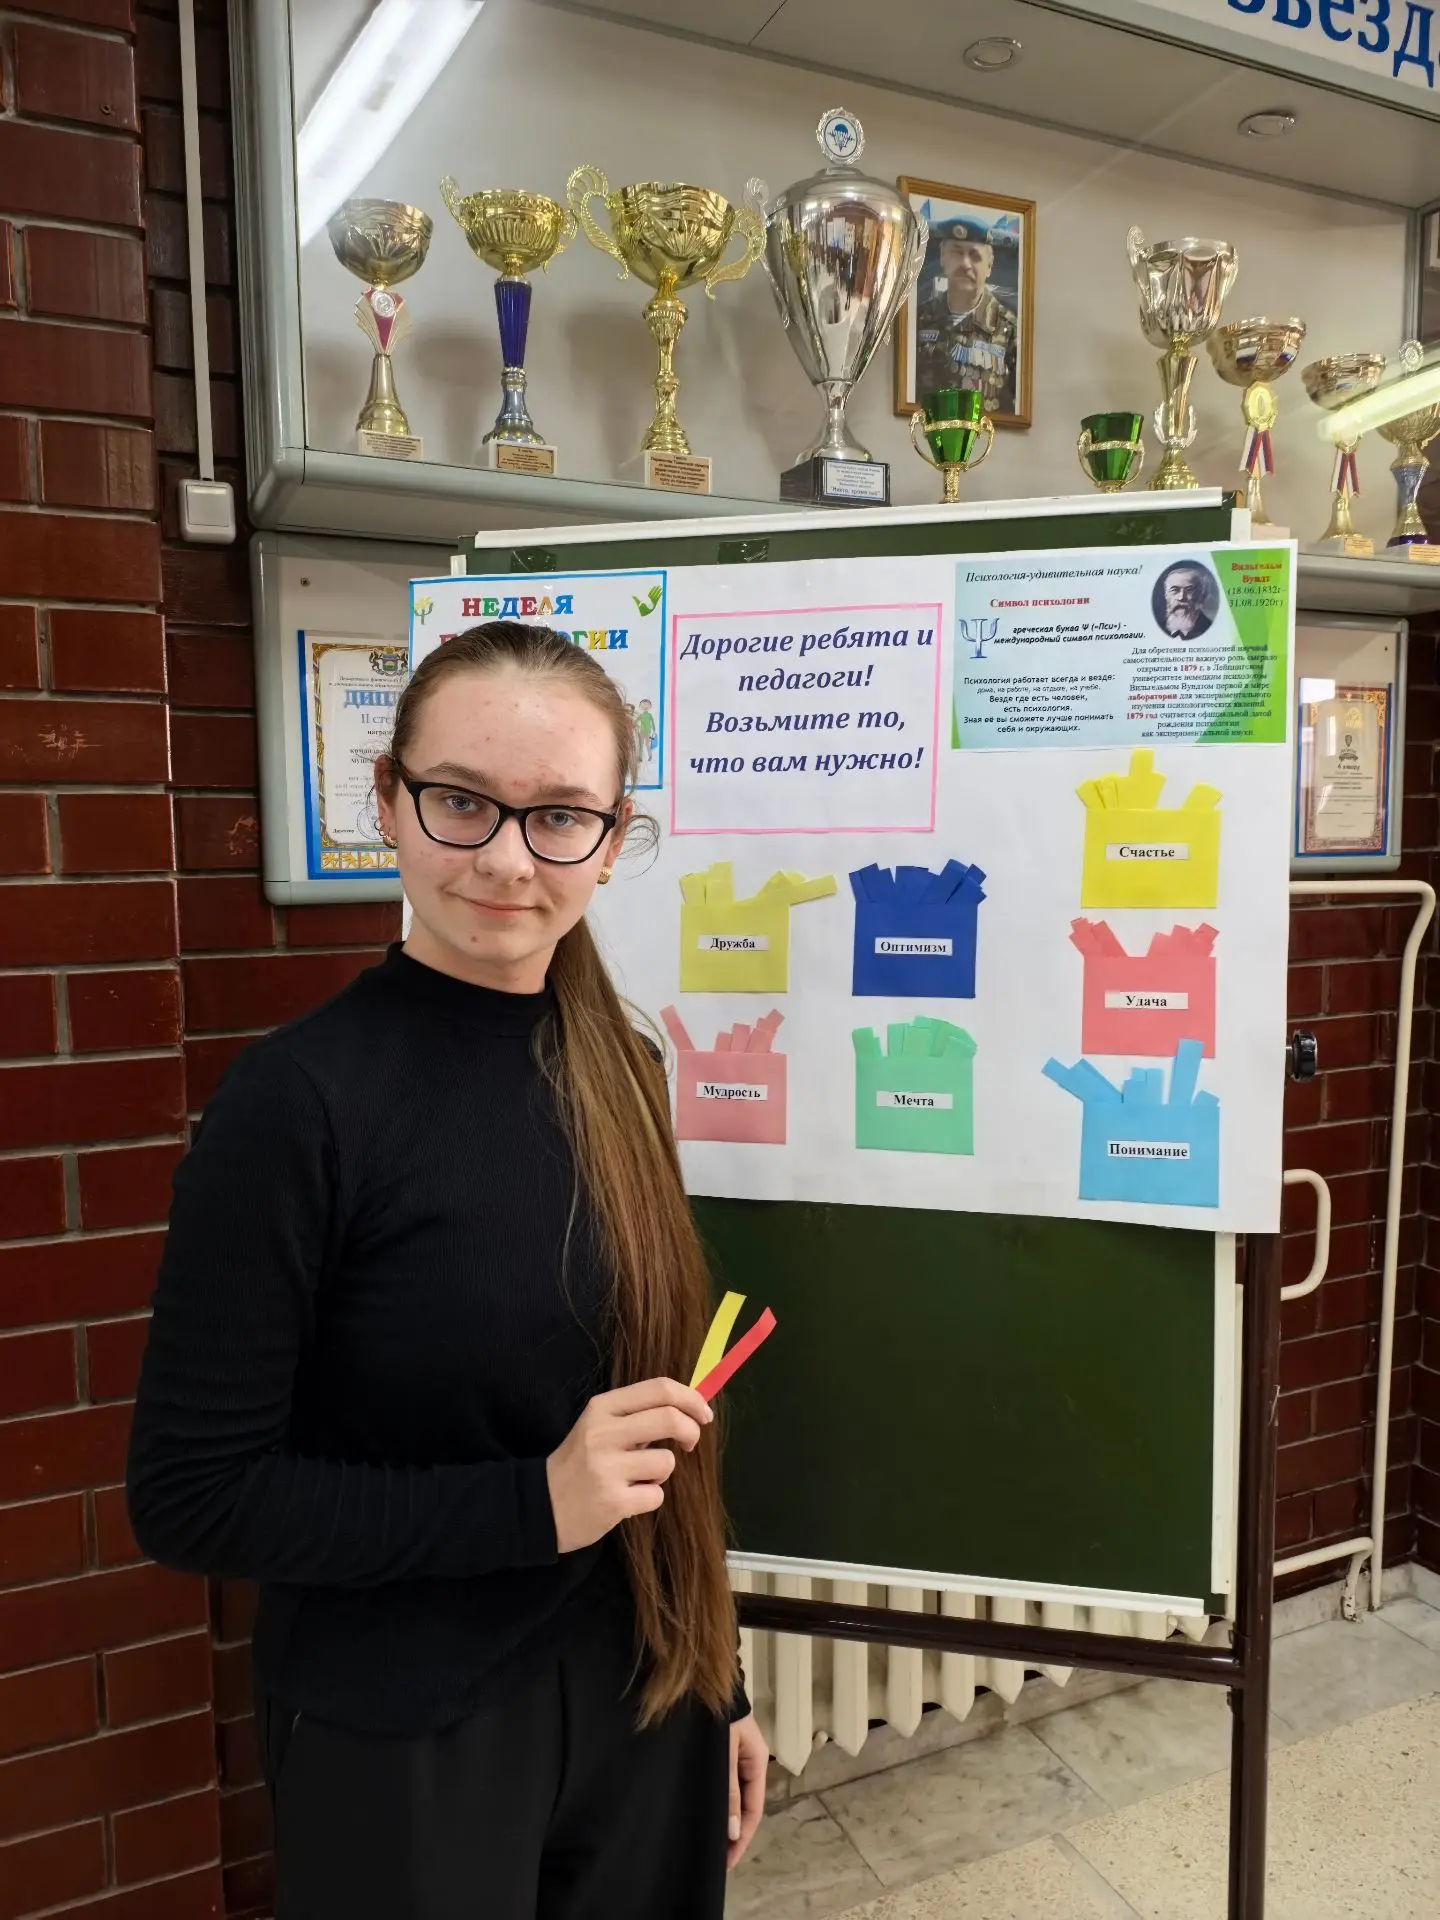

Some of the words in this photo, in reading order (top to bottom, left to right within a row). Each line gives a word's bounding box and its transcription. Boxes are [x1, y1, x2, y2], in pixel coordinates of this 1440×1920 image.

[966, 568, 1104, 583] Психология-удивительная
[1107, 565, 1143, 577] наука!
[462, 595, 574, 620] НЕДЕЛЯ
[990, 599, 1029, 608] Символ
[1032, 597, 1090, 607] психологии
[1013, 625, 1054, 634] греческая
[1056, 624, 1079, 633] буква
[680, 631, 794, 661] Дорогие
[799, 629, 908, 658] ребята
[917, 629, 934, 647] и
[994, 635, 1060, 645] международный
[1063, 634, 1092, 642] символ
[1095, 632, 1146, 641] психологии.
[1180, 664, 1197, 672] 1879
[738, 665, 874, 694] педагоги!
[964, 677, 1010, 685] Психология
[1013, 676, 1048, 685] работает
[1051, 675, 1078, 683] всегда
[1089, 674, 1116, 682] везде:
[990, 695, 1013, 703] Везде
[1024, 705, 1072, 713] психология.
[705, 711, 851, 734] Возьмите
[857, 711, 906, 733] то,
[1046, 715, 1072, 723] лучше
[1075, 714, 1114, 722] понимать
[998, 725, 1015, 733] себя
[1026, 725, 1080, 734] окружающих.
[690, 753, 746, 775] что
[752, 753, 807, 773] вам
[814, 746, 924, 778] нужно!
[1119, 845, 1175, 859] Счастье
[710, 936, 756, 951] Дружба
[880, 939, 947, 955] Оптимизм
[1125, 994, 1168, 1008] Удача
[703, 1084, 761, 1100] Мудрость
[893, 1093, 935, 1107] Мечта
[1109, 1142, 1188, 1158] Понимание
